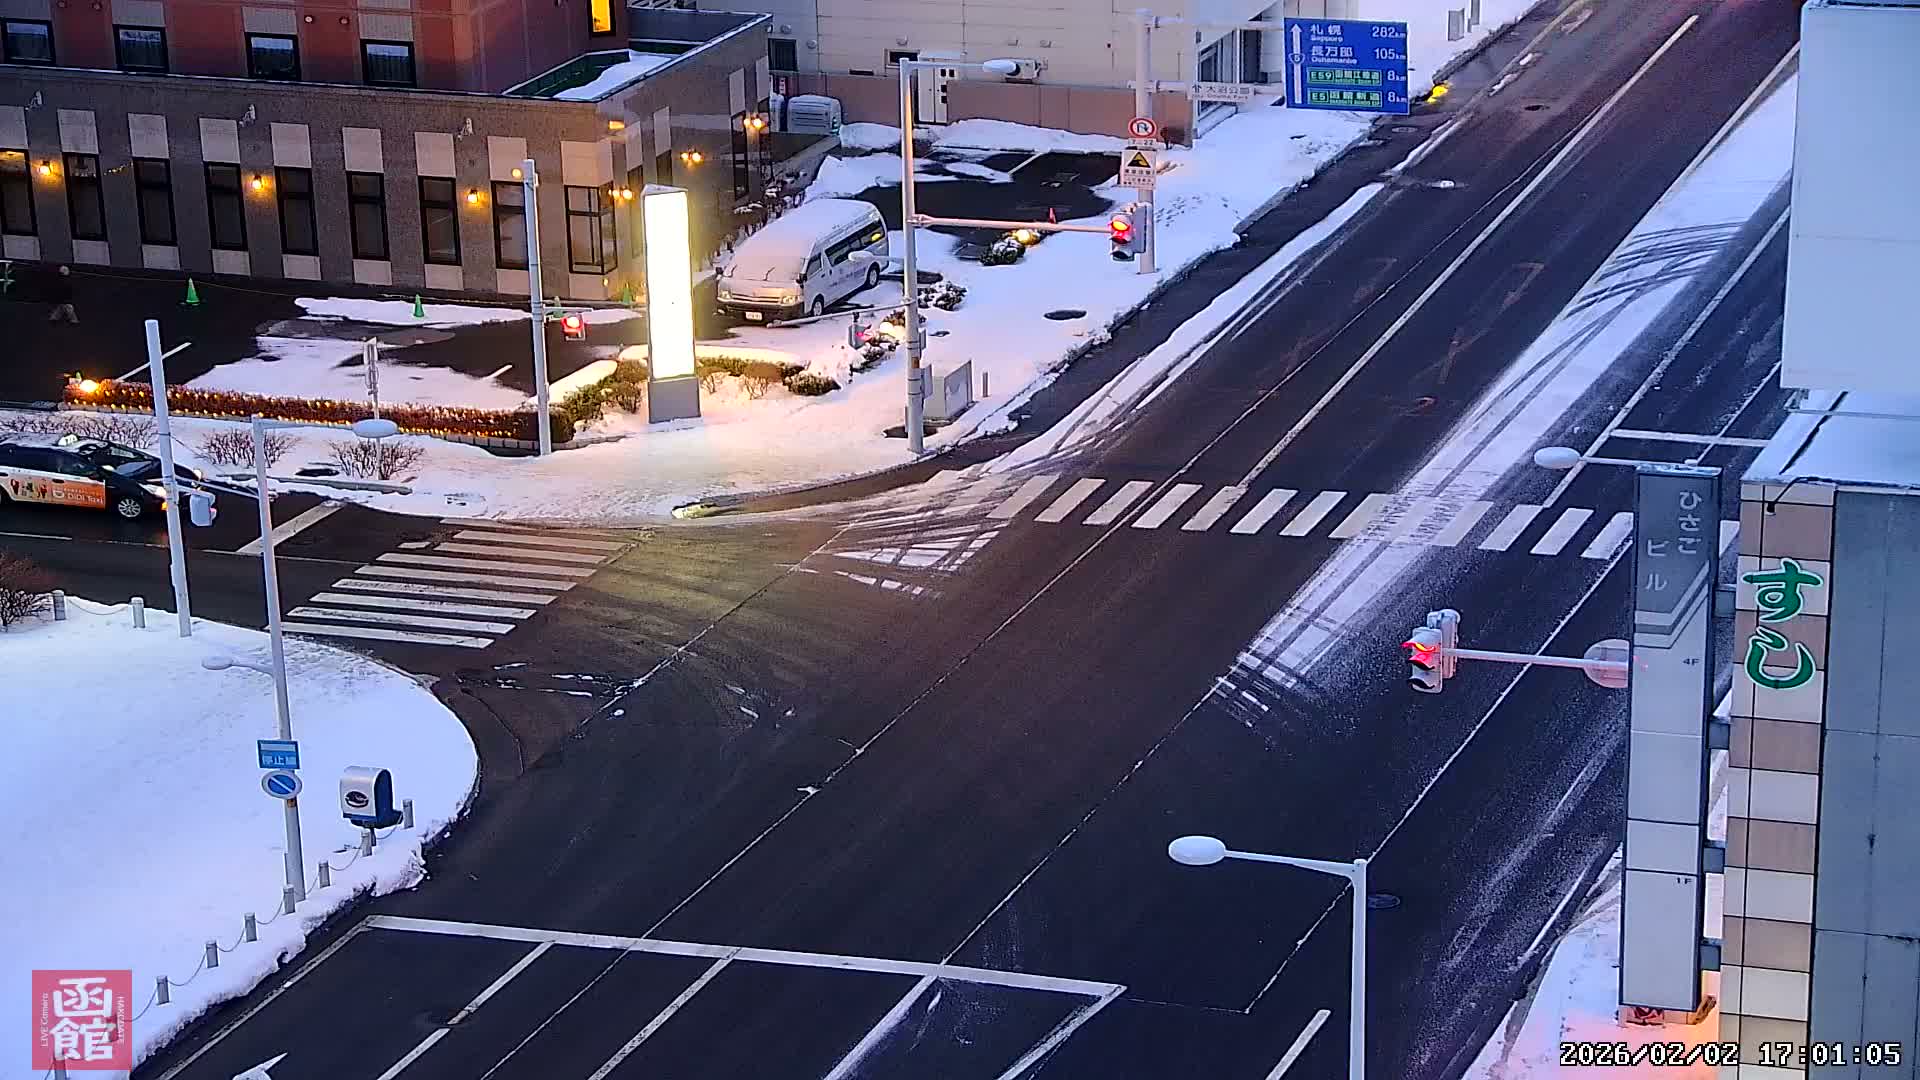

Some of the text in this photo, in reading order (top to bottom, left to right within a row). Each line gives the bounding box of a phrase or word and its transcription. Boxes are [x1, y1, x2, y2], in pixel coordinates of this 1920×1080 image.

[1310, 24, 1342, 36] 札幌
[1311, 45, 1353, 57] 長万部
[1310, 71, 1332, 80] E59
[1311, 91, 1327, 101] E5
[1678, 491, 1702, 554] ひさご
[1646, 539, 1669, 591] ビル
[1743, 557, 1824, 689] すし
[1682, 658, 1700, 666] 4F
[1676, 877, 1691, 885] 1F
